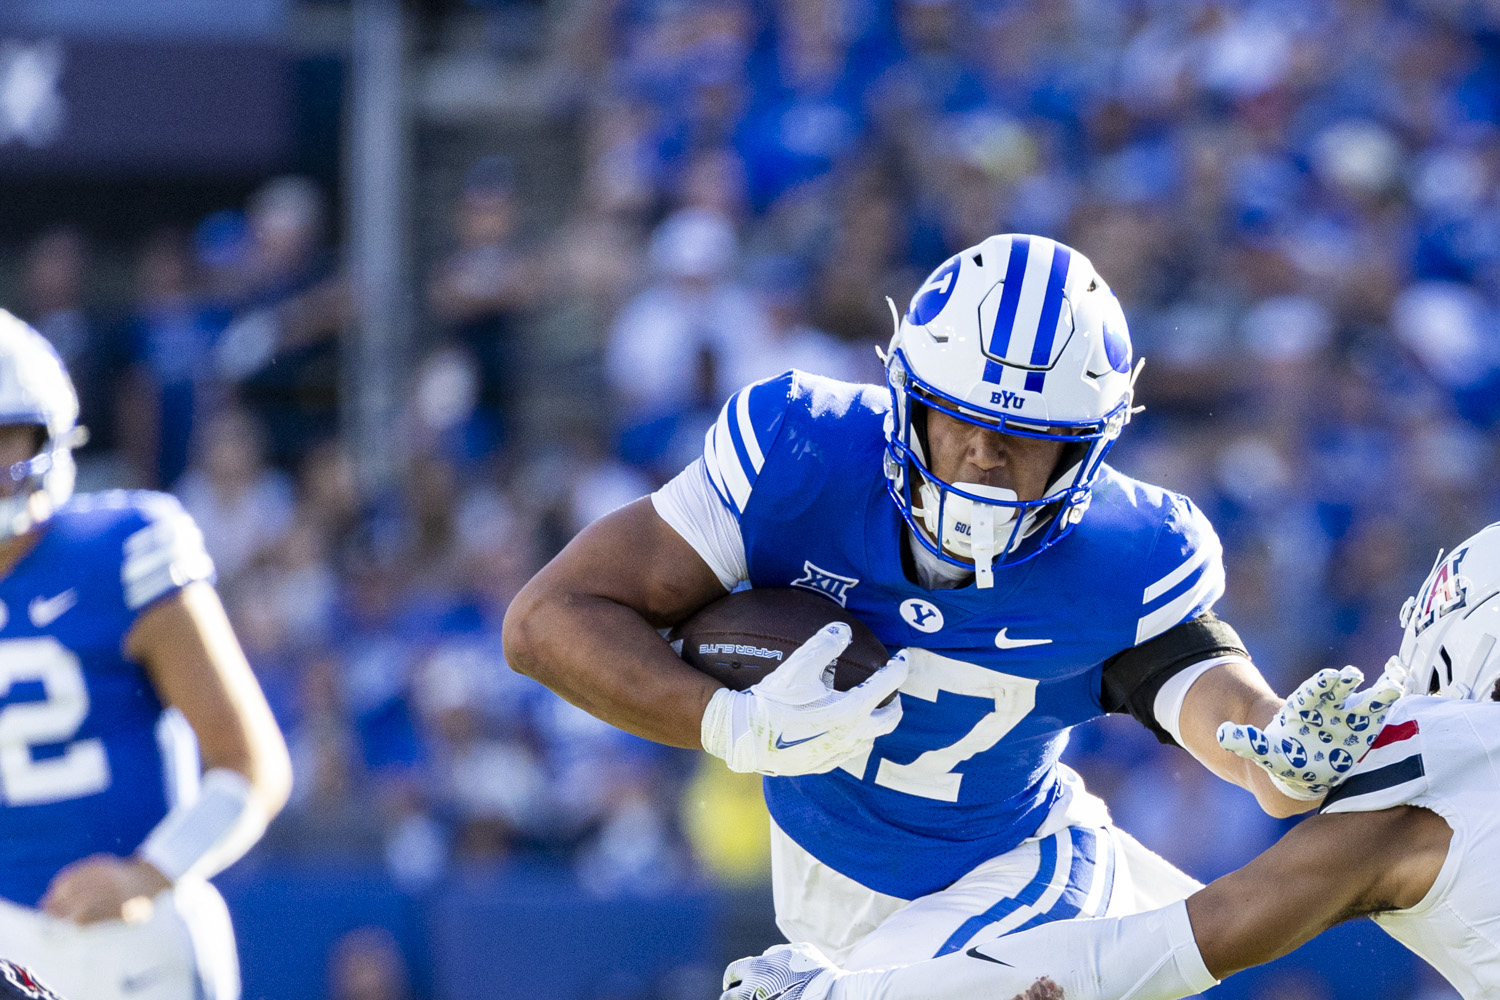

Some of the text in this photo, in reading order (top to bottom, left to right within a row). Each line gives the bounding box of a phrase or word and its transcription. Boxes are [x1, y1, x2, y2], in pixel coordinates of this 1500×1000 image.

[990, 390, 1025, 409] BYU
[791, 561, 859, 607] XII
[910, 603, 937, 627] Y
[699, 643, 783, 661] VAPOR ELITE
[832, 646, 1040, 803] 7
